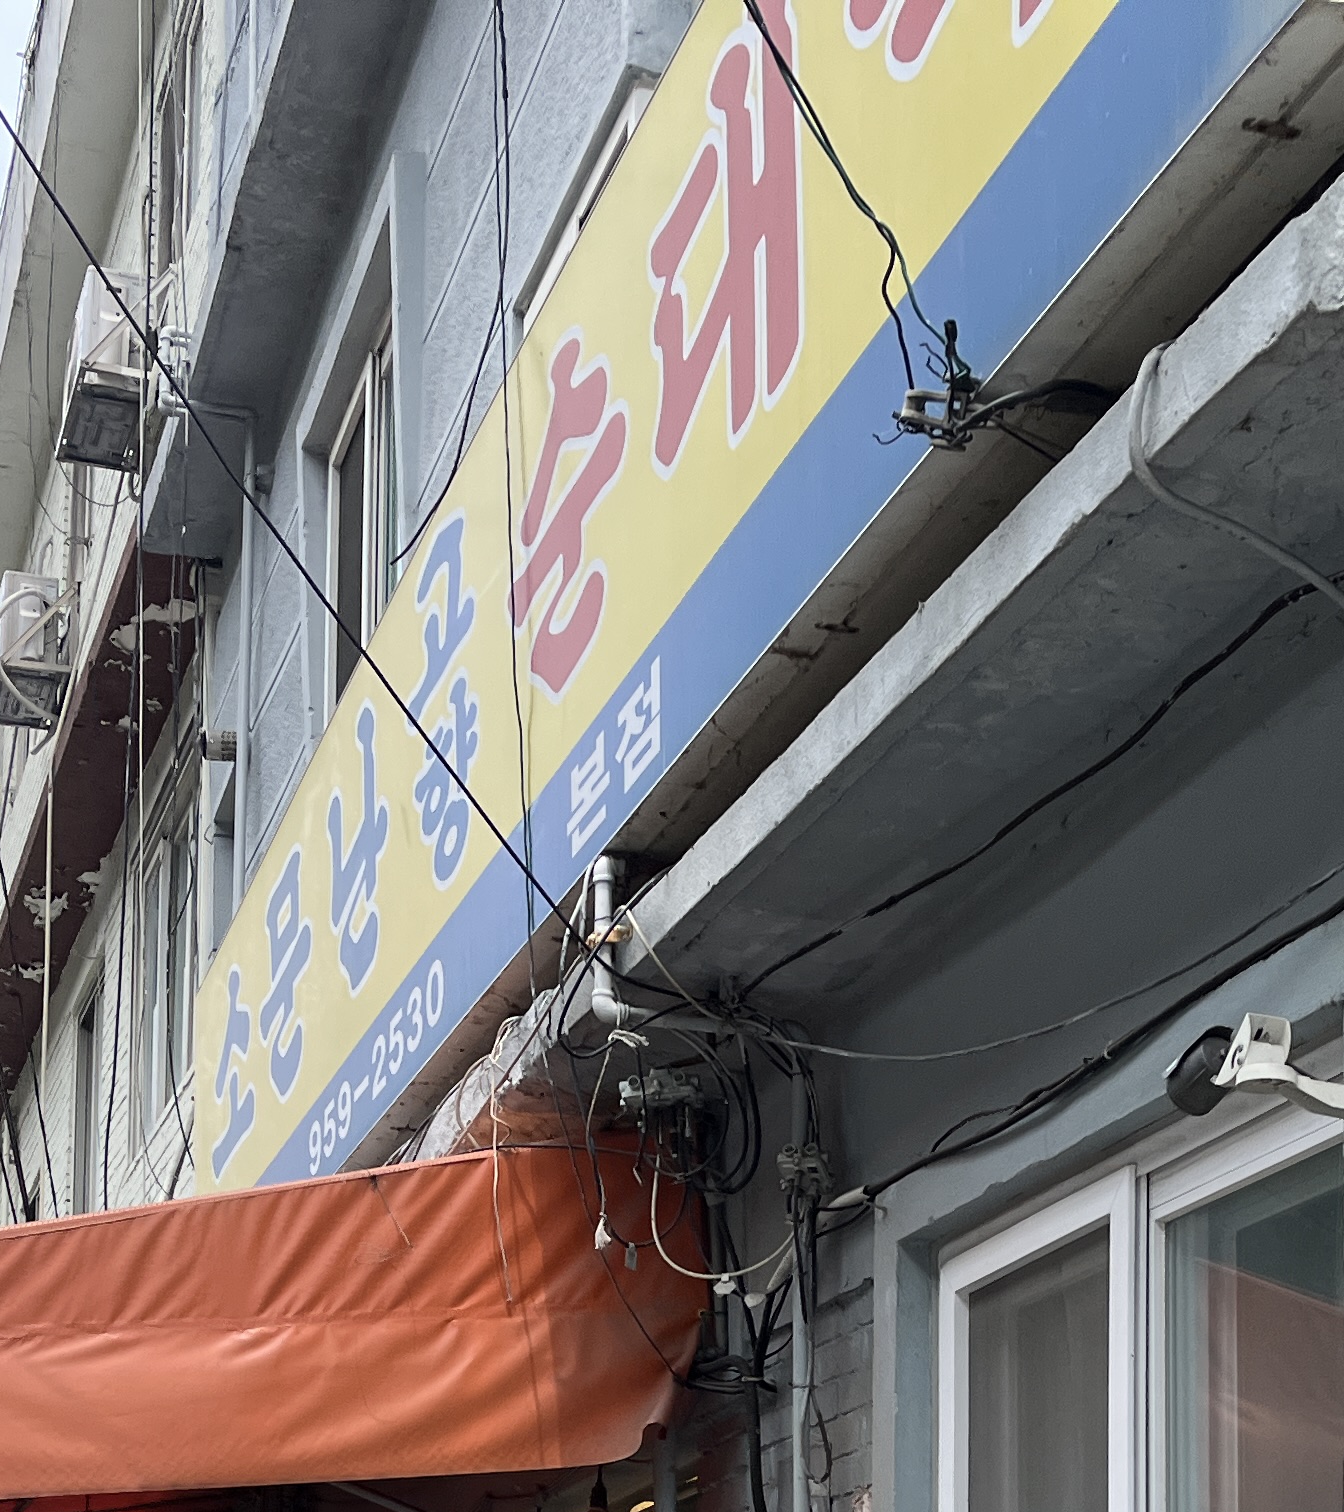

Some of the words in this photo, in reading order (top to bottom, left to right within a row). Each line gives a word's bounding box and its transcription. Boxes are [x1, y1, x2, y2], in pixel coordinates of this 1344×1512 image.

[211, 698, 389, 1186] 소문난
[404, 507, 480, 892] 고향
[565, 654, 664, 858] 본점
[308, 959, 445, 1176] 959-2530
